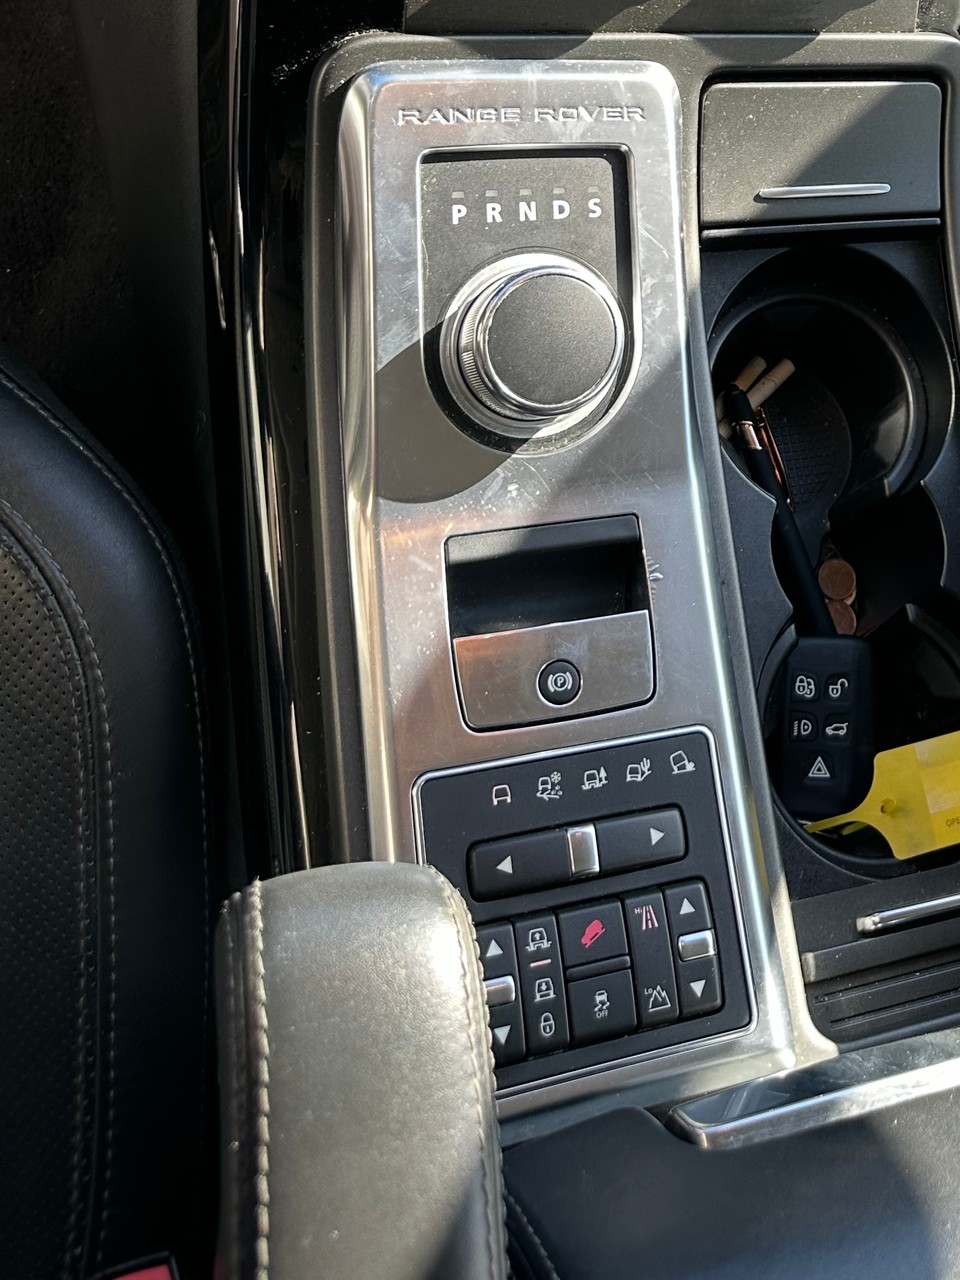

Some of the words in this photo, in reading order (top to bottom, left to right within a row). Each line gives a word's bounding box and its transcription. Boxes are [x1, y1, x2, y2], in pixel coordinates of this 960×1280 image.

[396, 106, 522, 126] RANGE
[534, 106, 646, 123] ROVER
[451, 204, 468, 225] P
[486, 202, 503, 223] R
[519, 201, 537, 222] N
[553, 200, 571, 220] D
[588, 197, 602, 218] S
[595, 1010, 609, 1019] OFF
